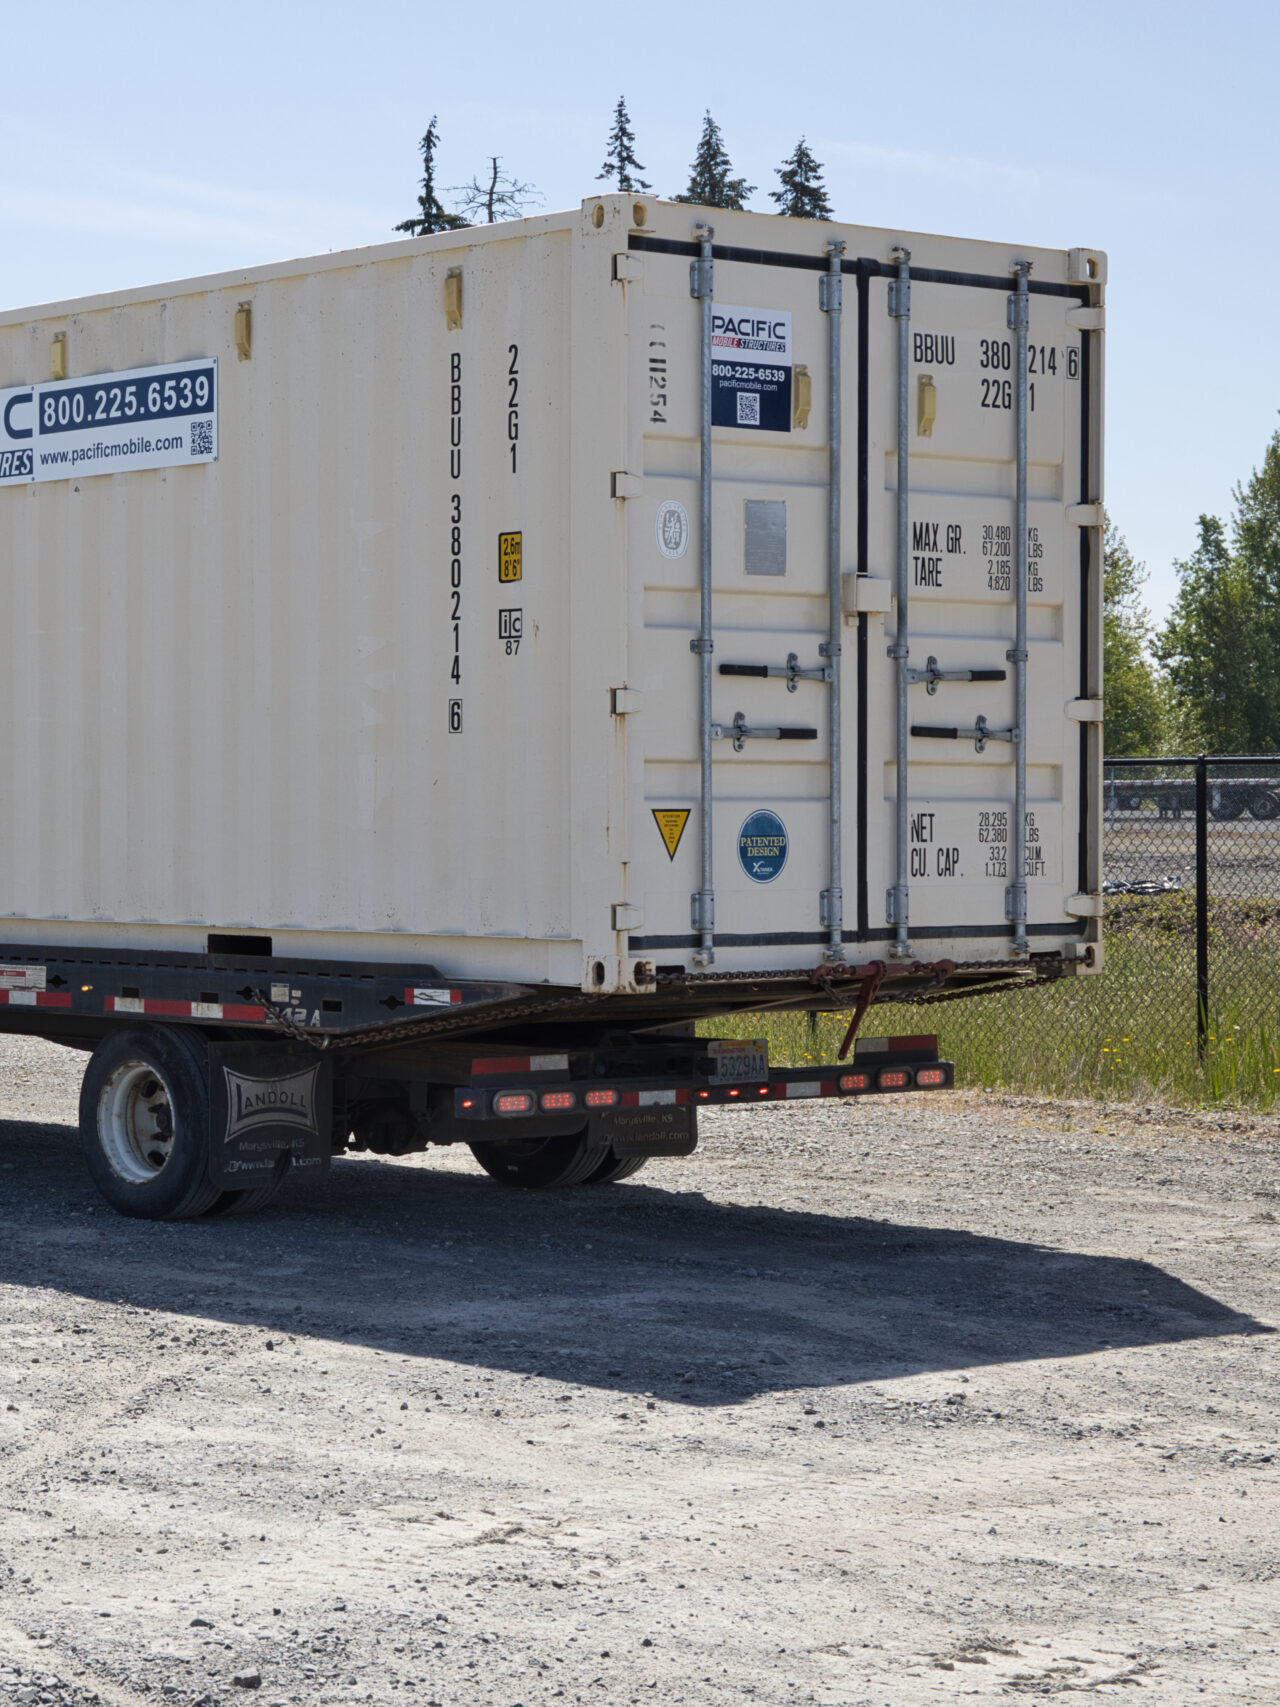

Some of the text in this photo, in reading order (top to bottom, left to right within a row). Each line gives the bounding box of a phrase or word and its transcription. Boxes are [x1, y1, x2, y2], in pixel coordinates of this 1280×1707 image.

[712, 336, 786, 352] MOBILE STRUCTURES
[913, 332, 955, 366] BBUU
[712, 364, 785, 382] 800-225-6539
[719, 379, 778, 391] pacificmobile.com
[43, 375, 210, 428] 800.225.6539
[450, 352, 462, 479] BBUU
[508, 344, 519, 474] 22G1
[40, 436, 183, 466] www.pacificmobile.com
[912, 521, 1039, 555] MAX. GR. 30.480 KG
[982, 541, 1043, 558] 67.200 LBS
[913, 556, 1039, 588] TARE 2.185 KG
[987, 576, 1044, 592] 4.820 LBS
[505, 640, 520, 656] 87
[740, 836, 786, 847] PATENTED
[910, 813, 936, 843] NET
[978, 812, 1008, 827] 28.295
[978, 828, 1008, 843] 62.380
[747, 847, 780, 857] DESIGN
[910, 847, 931, 878] CU.
[989, 846, 1008, 861] 33.2
[235, 1083, 309, 1121] LANDOLL
